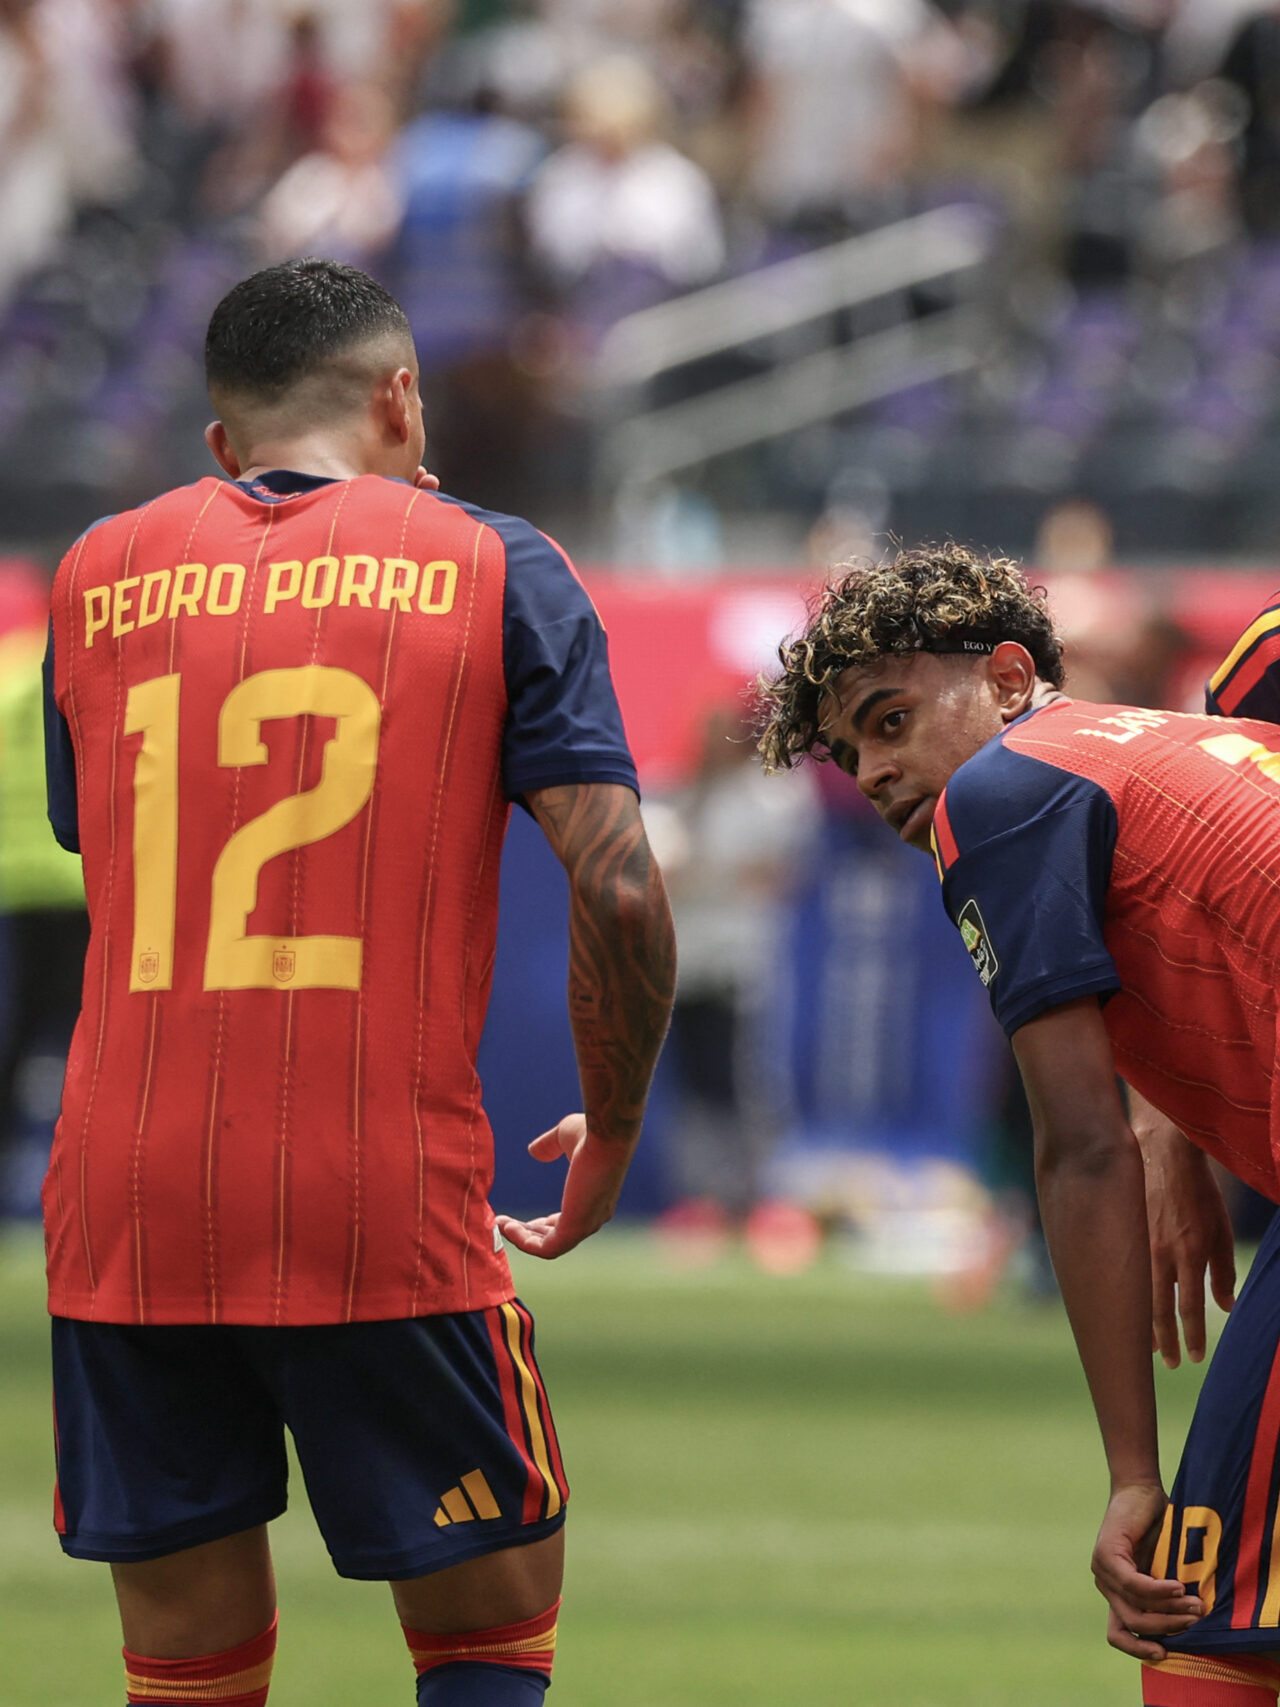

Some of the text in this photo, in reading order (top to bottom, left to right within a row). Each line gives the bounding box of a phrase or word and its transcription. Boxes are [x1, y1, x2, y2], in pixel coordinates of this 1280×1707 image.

[83, 553, 458, 648] PEDRO PORRO
[963, 640, 984, 651] EGO
[124, 662, 383, 993] 12
